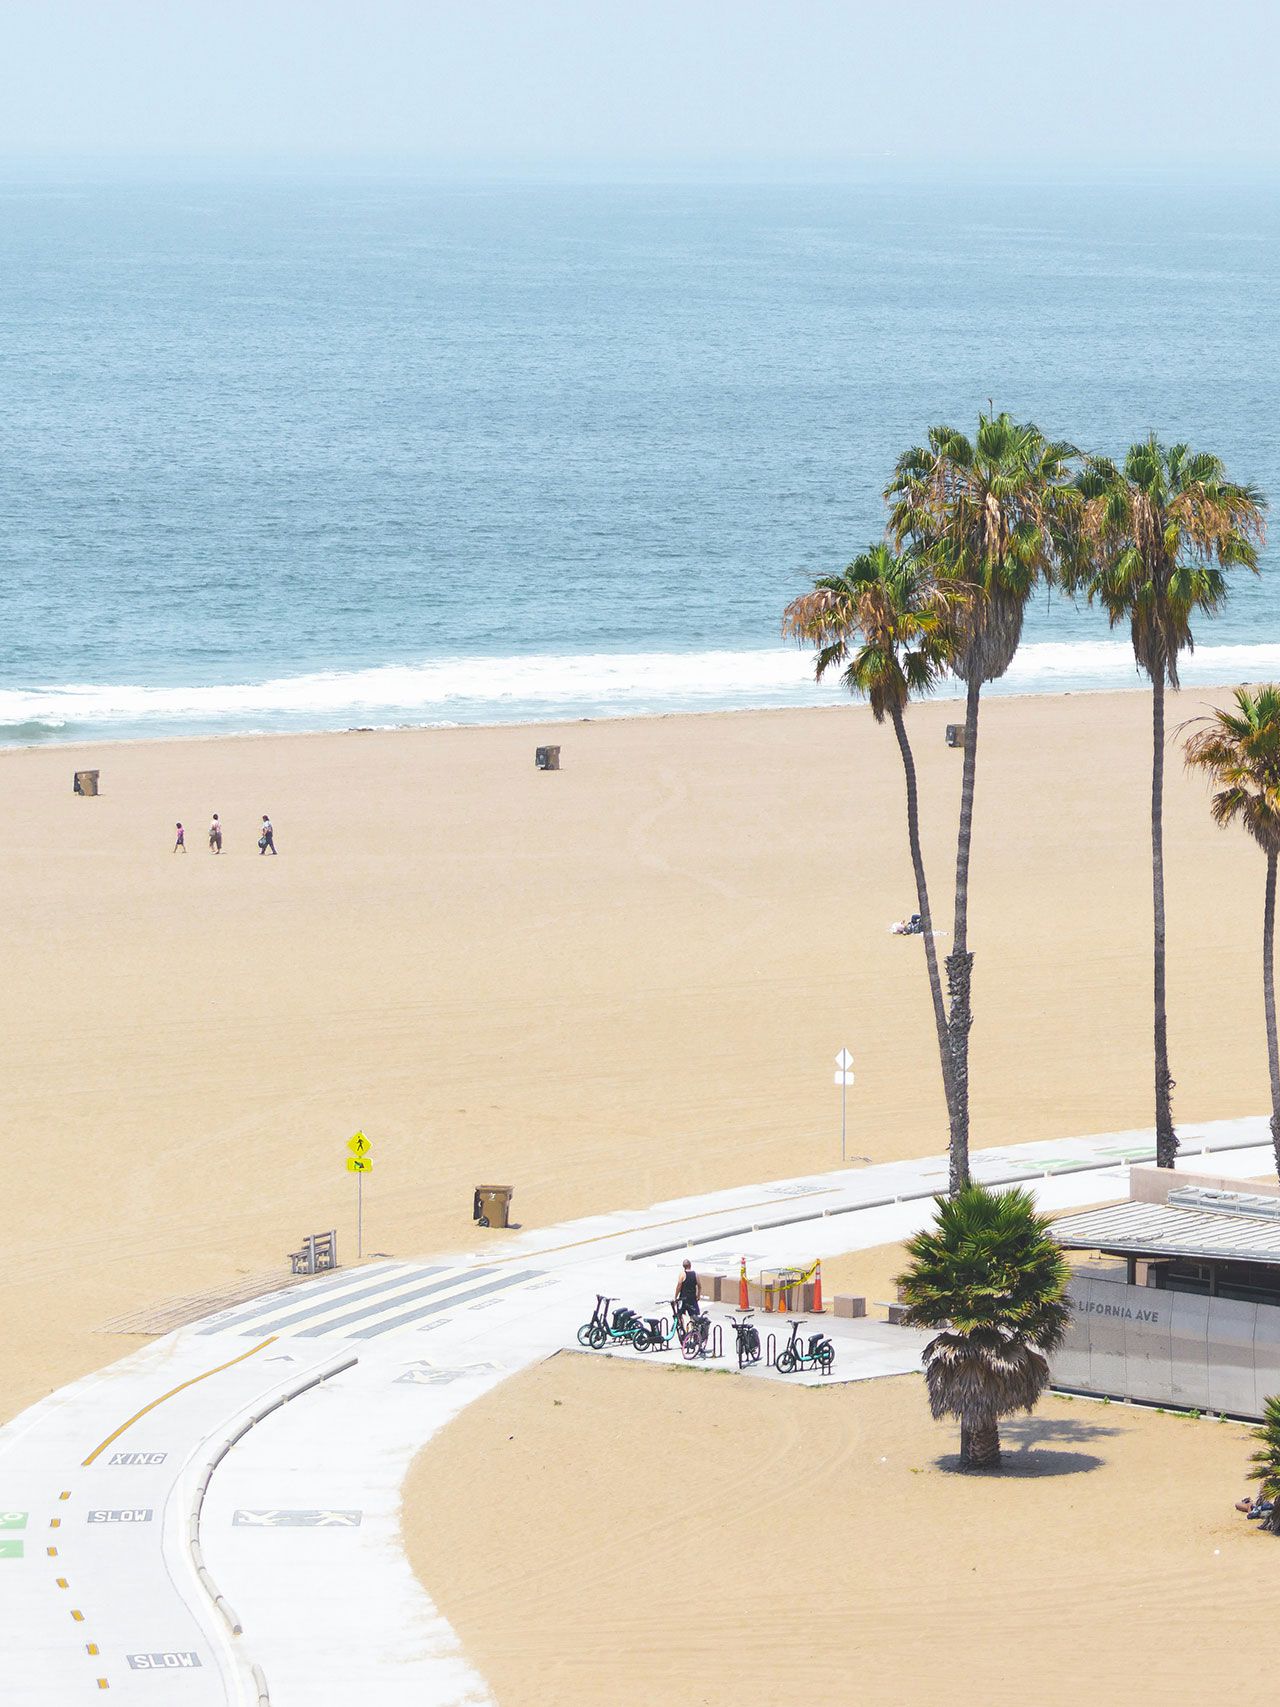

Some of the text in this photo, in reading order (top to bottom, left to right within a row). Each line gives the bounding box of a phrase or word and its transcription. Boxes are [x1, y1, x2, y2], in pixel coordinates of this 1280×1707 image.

[1078, 1301, 1159, 1323] LIFORNIA AVE
[112, 1453, 164, 1465] XING
[94, 1510, 147, 1521] SLOW
[133, 1653, 192, 1668] SLOW
